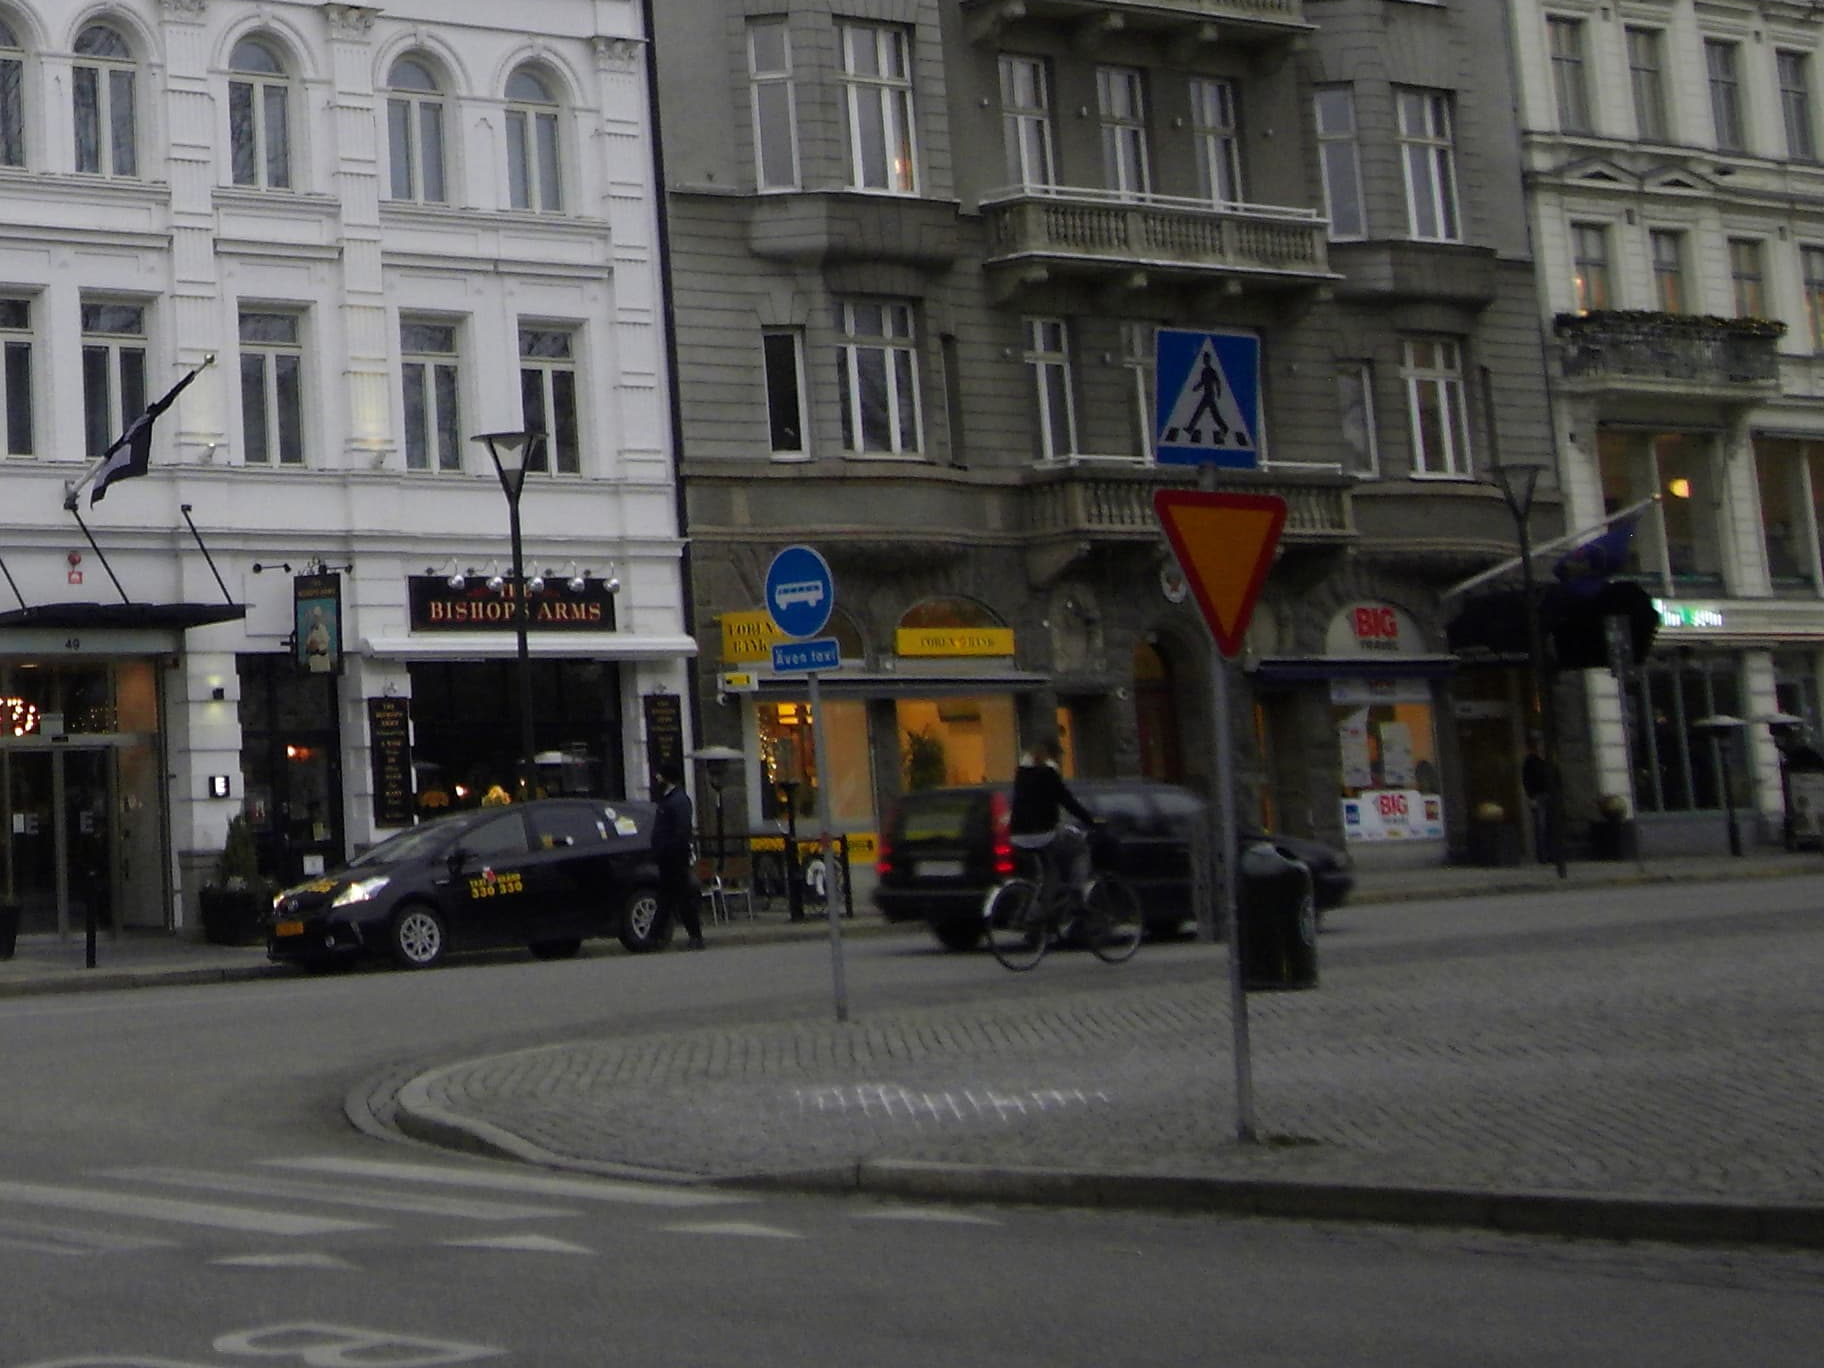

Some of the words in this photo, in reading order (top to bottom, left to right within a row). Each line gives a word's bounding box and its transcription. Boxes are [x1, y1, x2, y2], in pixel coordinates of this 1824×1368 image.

[537, 602, 602, 622] ARMS
[1354, 606, 1399, 639] BIG
[65, 638, 80, 651] 49
[776, 649, 807, 665] Även
[812, 649, 836, 663] taxi
[1379, 794, 1408, 816] BIG
[471, 887, 496, 899] 330
[499, 882, 523, 894] 330
